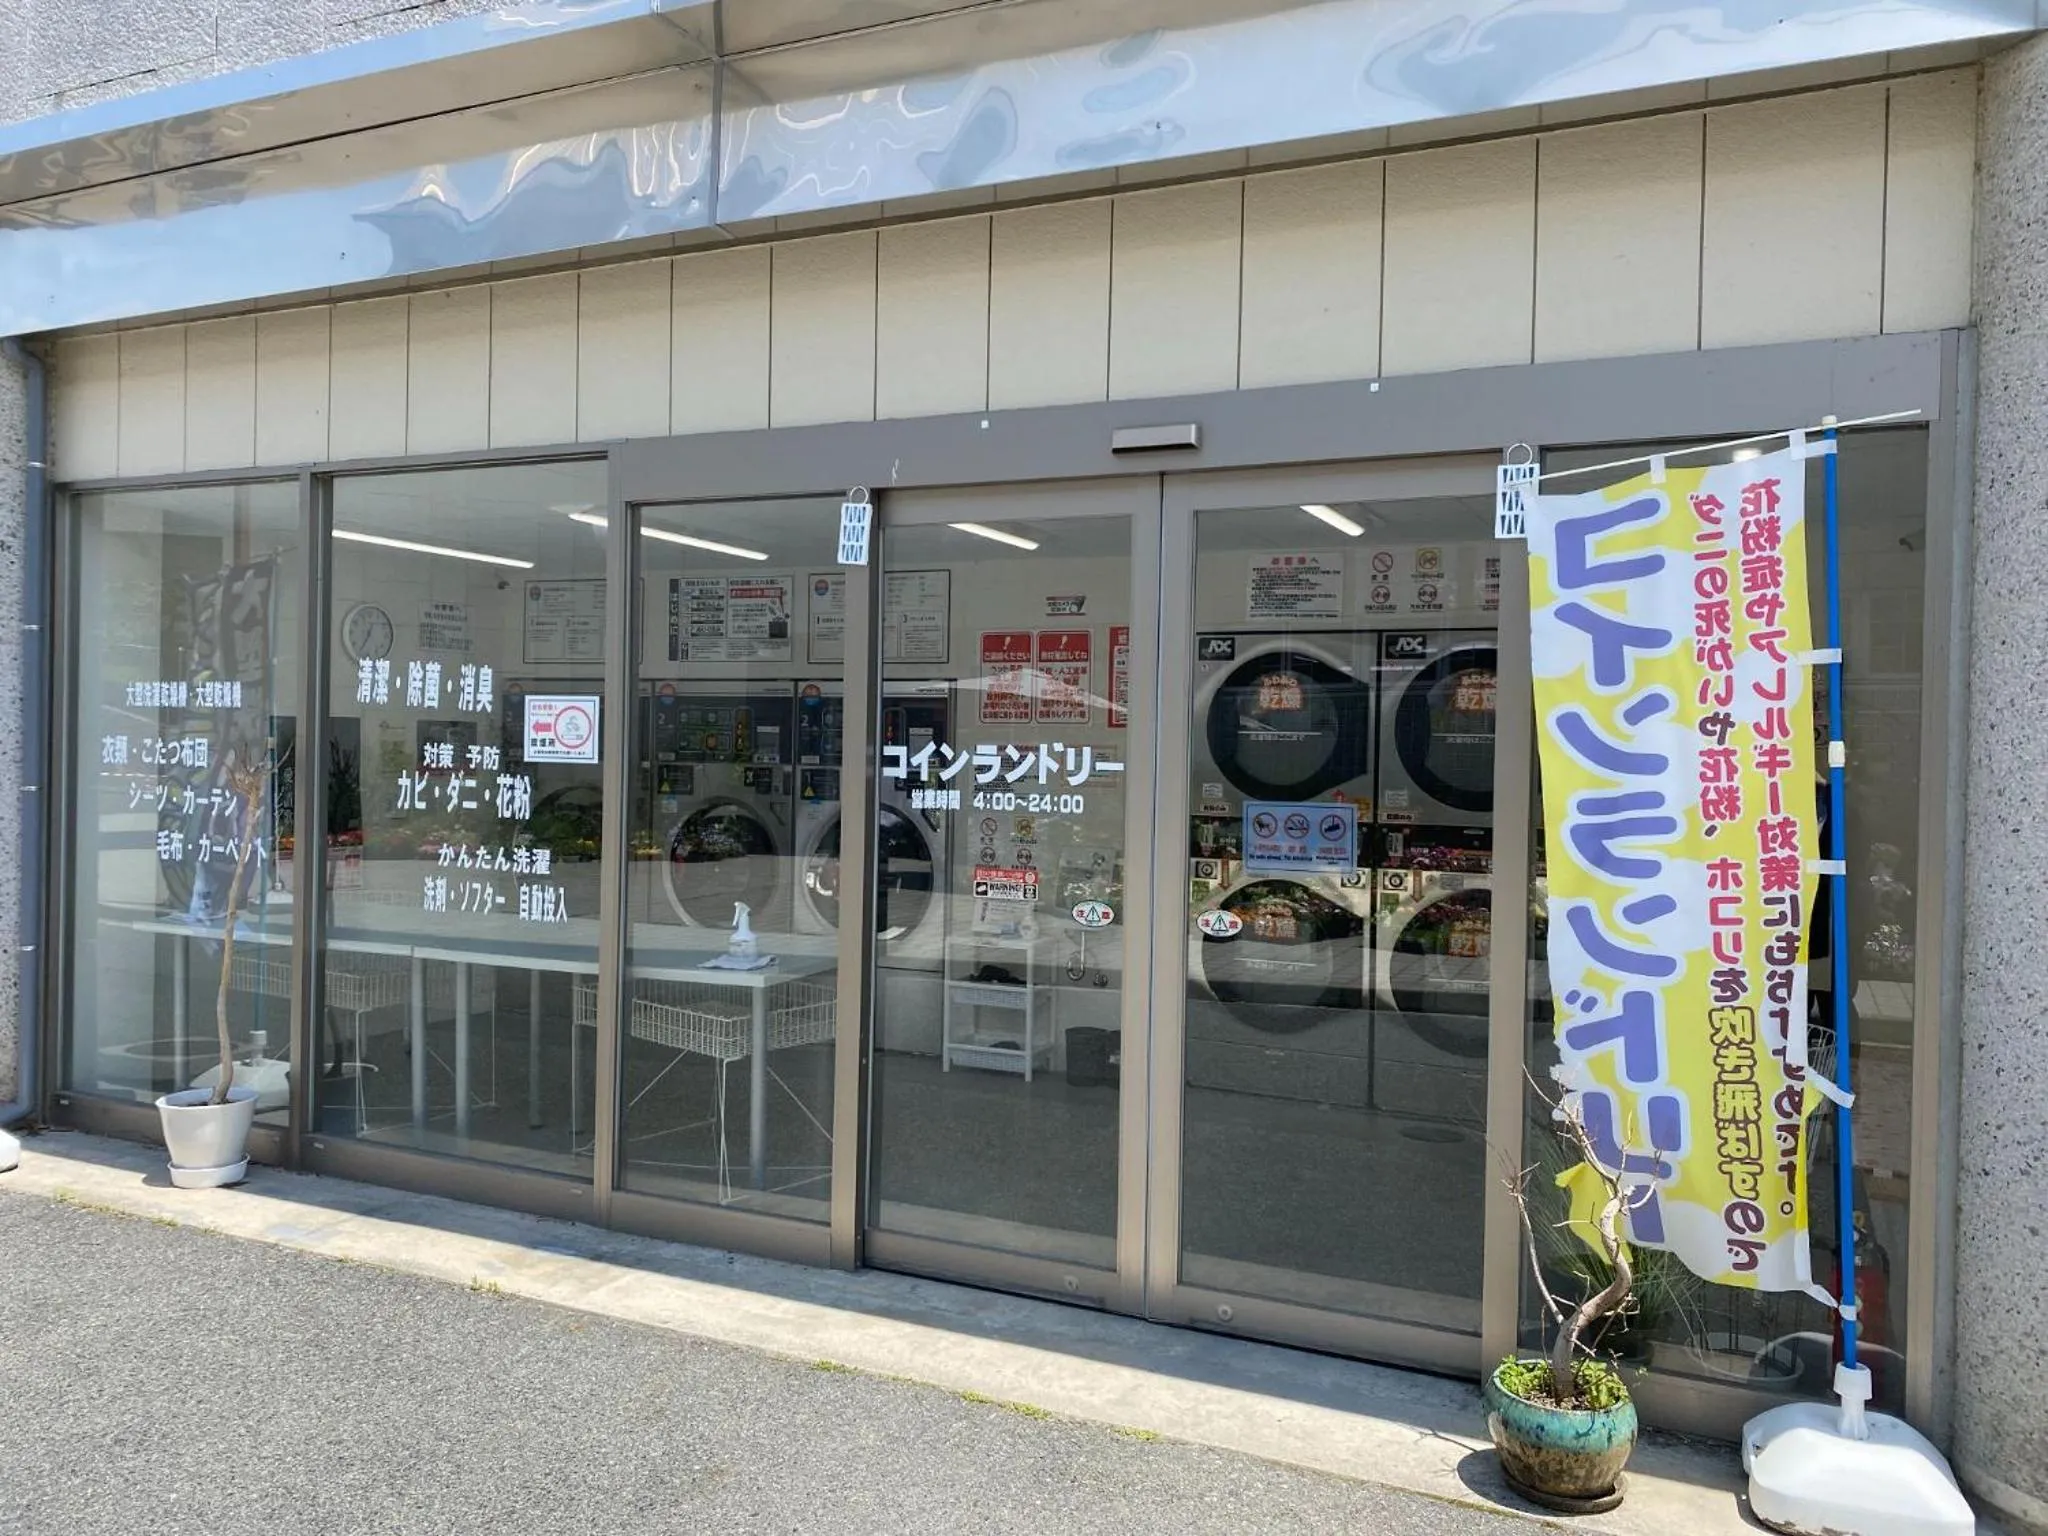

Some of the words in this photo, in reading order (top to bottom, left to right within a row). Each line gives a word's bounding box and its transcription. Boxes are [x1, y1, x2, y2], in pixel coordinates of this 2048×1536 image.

[357, 657, 493, 713] 清潔・除菌・消臭
[102, 736, 208, 768] 衣類・こたつ布団
[423, 742, 454, 769] 対策
[466, 745, 500, 770] 予防
[882, 740, 1125, 786] コインランドリー
[129, 782, 237, 817] シーツ・カーテン
[397, 768, 531, 820] カビ・ダニ・花粉
[911, 789, 960, 810] 営業時間
[438, 843, 551, 875] かんたん洗濯
[424, 875, 506, 915] 洗剤・ソフター
[519, 883, 568, 924] 自動投入
